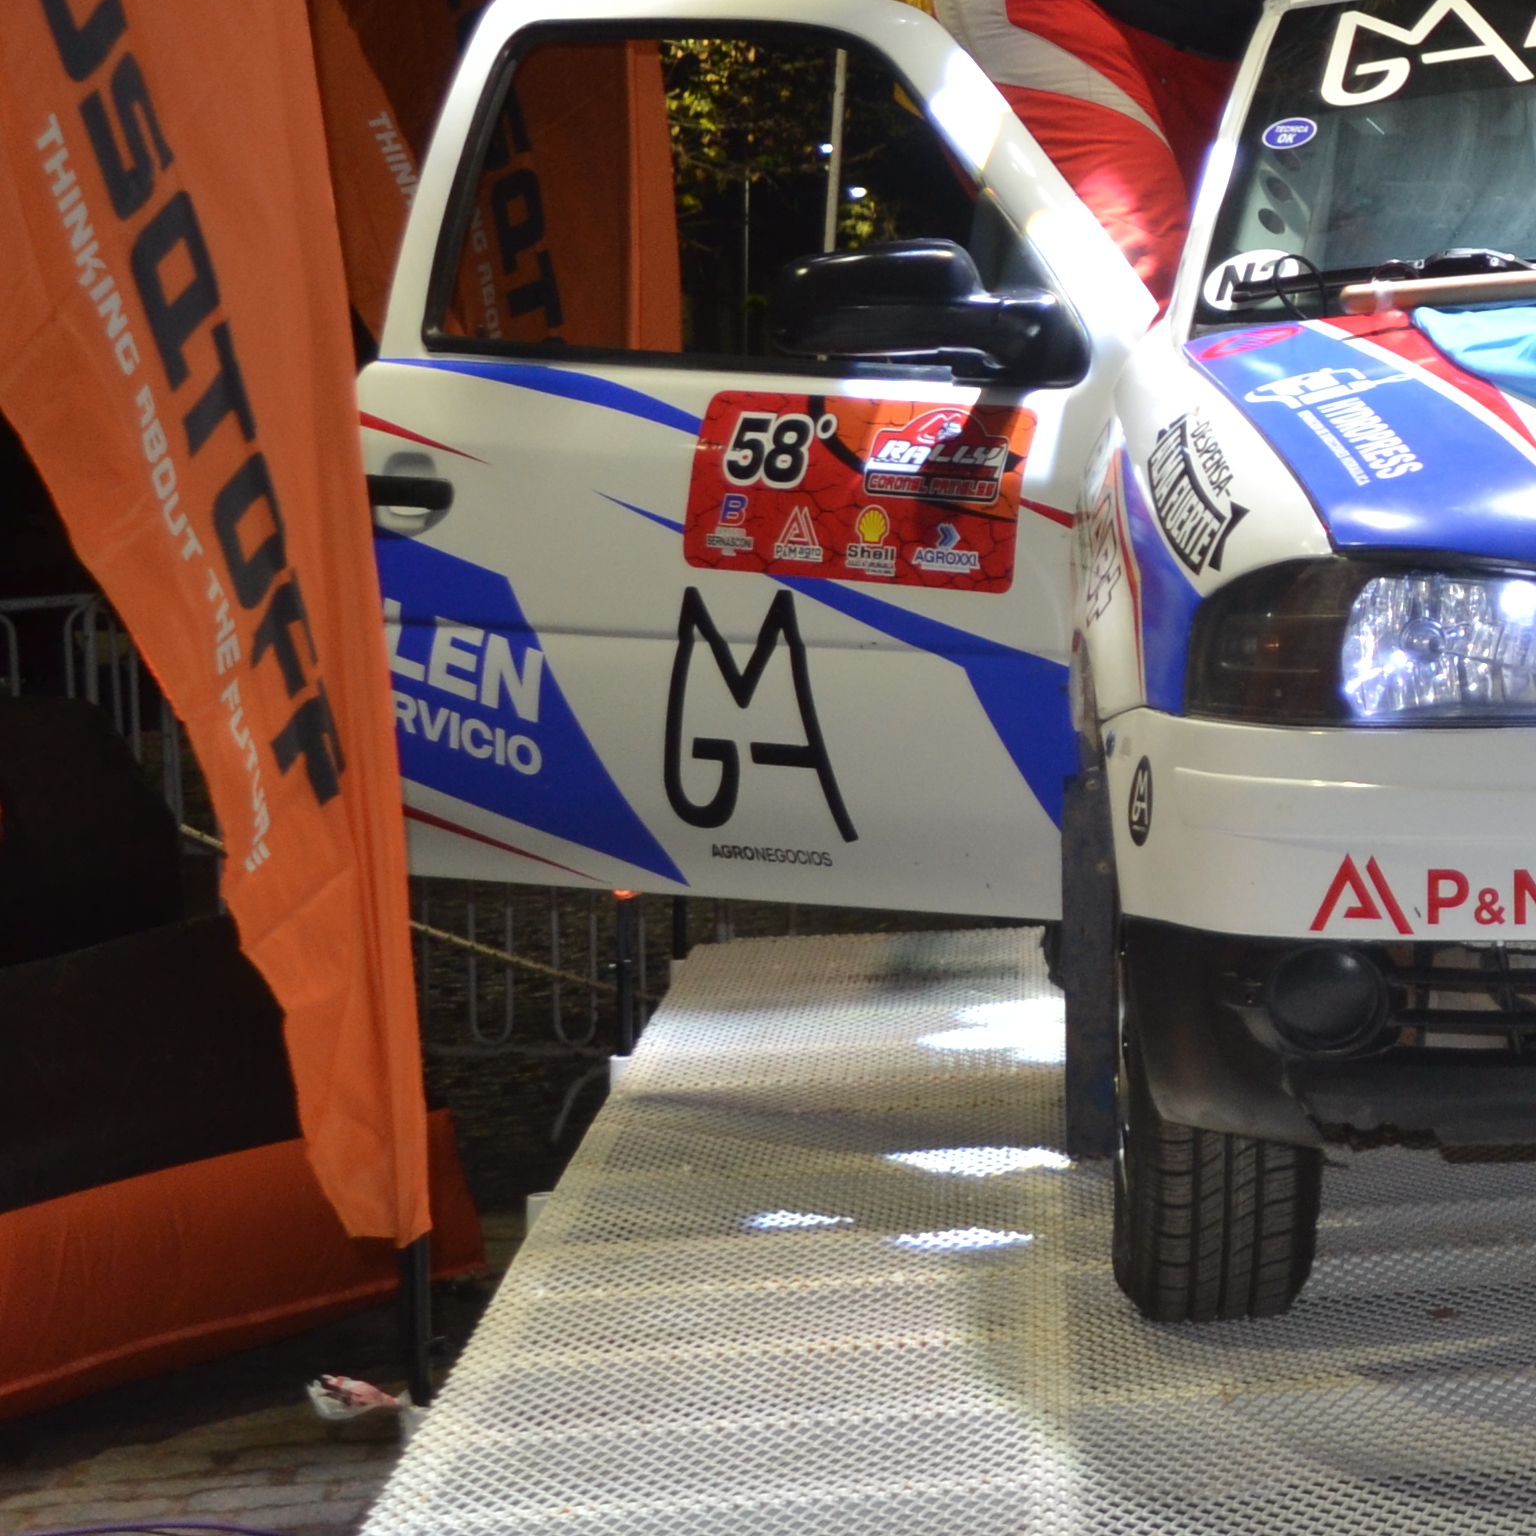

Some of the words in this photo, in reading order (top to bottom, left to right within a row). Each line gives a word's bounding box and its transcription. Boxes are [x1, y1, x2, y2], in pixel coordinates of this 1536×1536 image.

[1276, 133, 1297, 144] OK
[32, 115, 142, 376] THINKING
[134, 385, 205, 562] ABOUT
[876, 439, 1006, 466] RALLY
[1151, 427, 1186, 509] ALMA
[1317, 396, 1424, 479] HYDROPRESS
[847, 545, 895, 560] Shell
[914, 549, 978, 567] AGROXXI
[1161, 474, 1221, 565] FUERTE
[206, 568, 242, 676] THE
[219, 677, 272, 873] FUTURE
[711, 844, 833, 866] AGRONEGOCIOS
